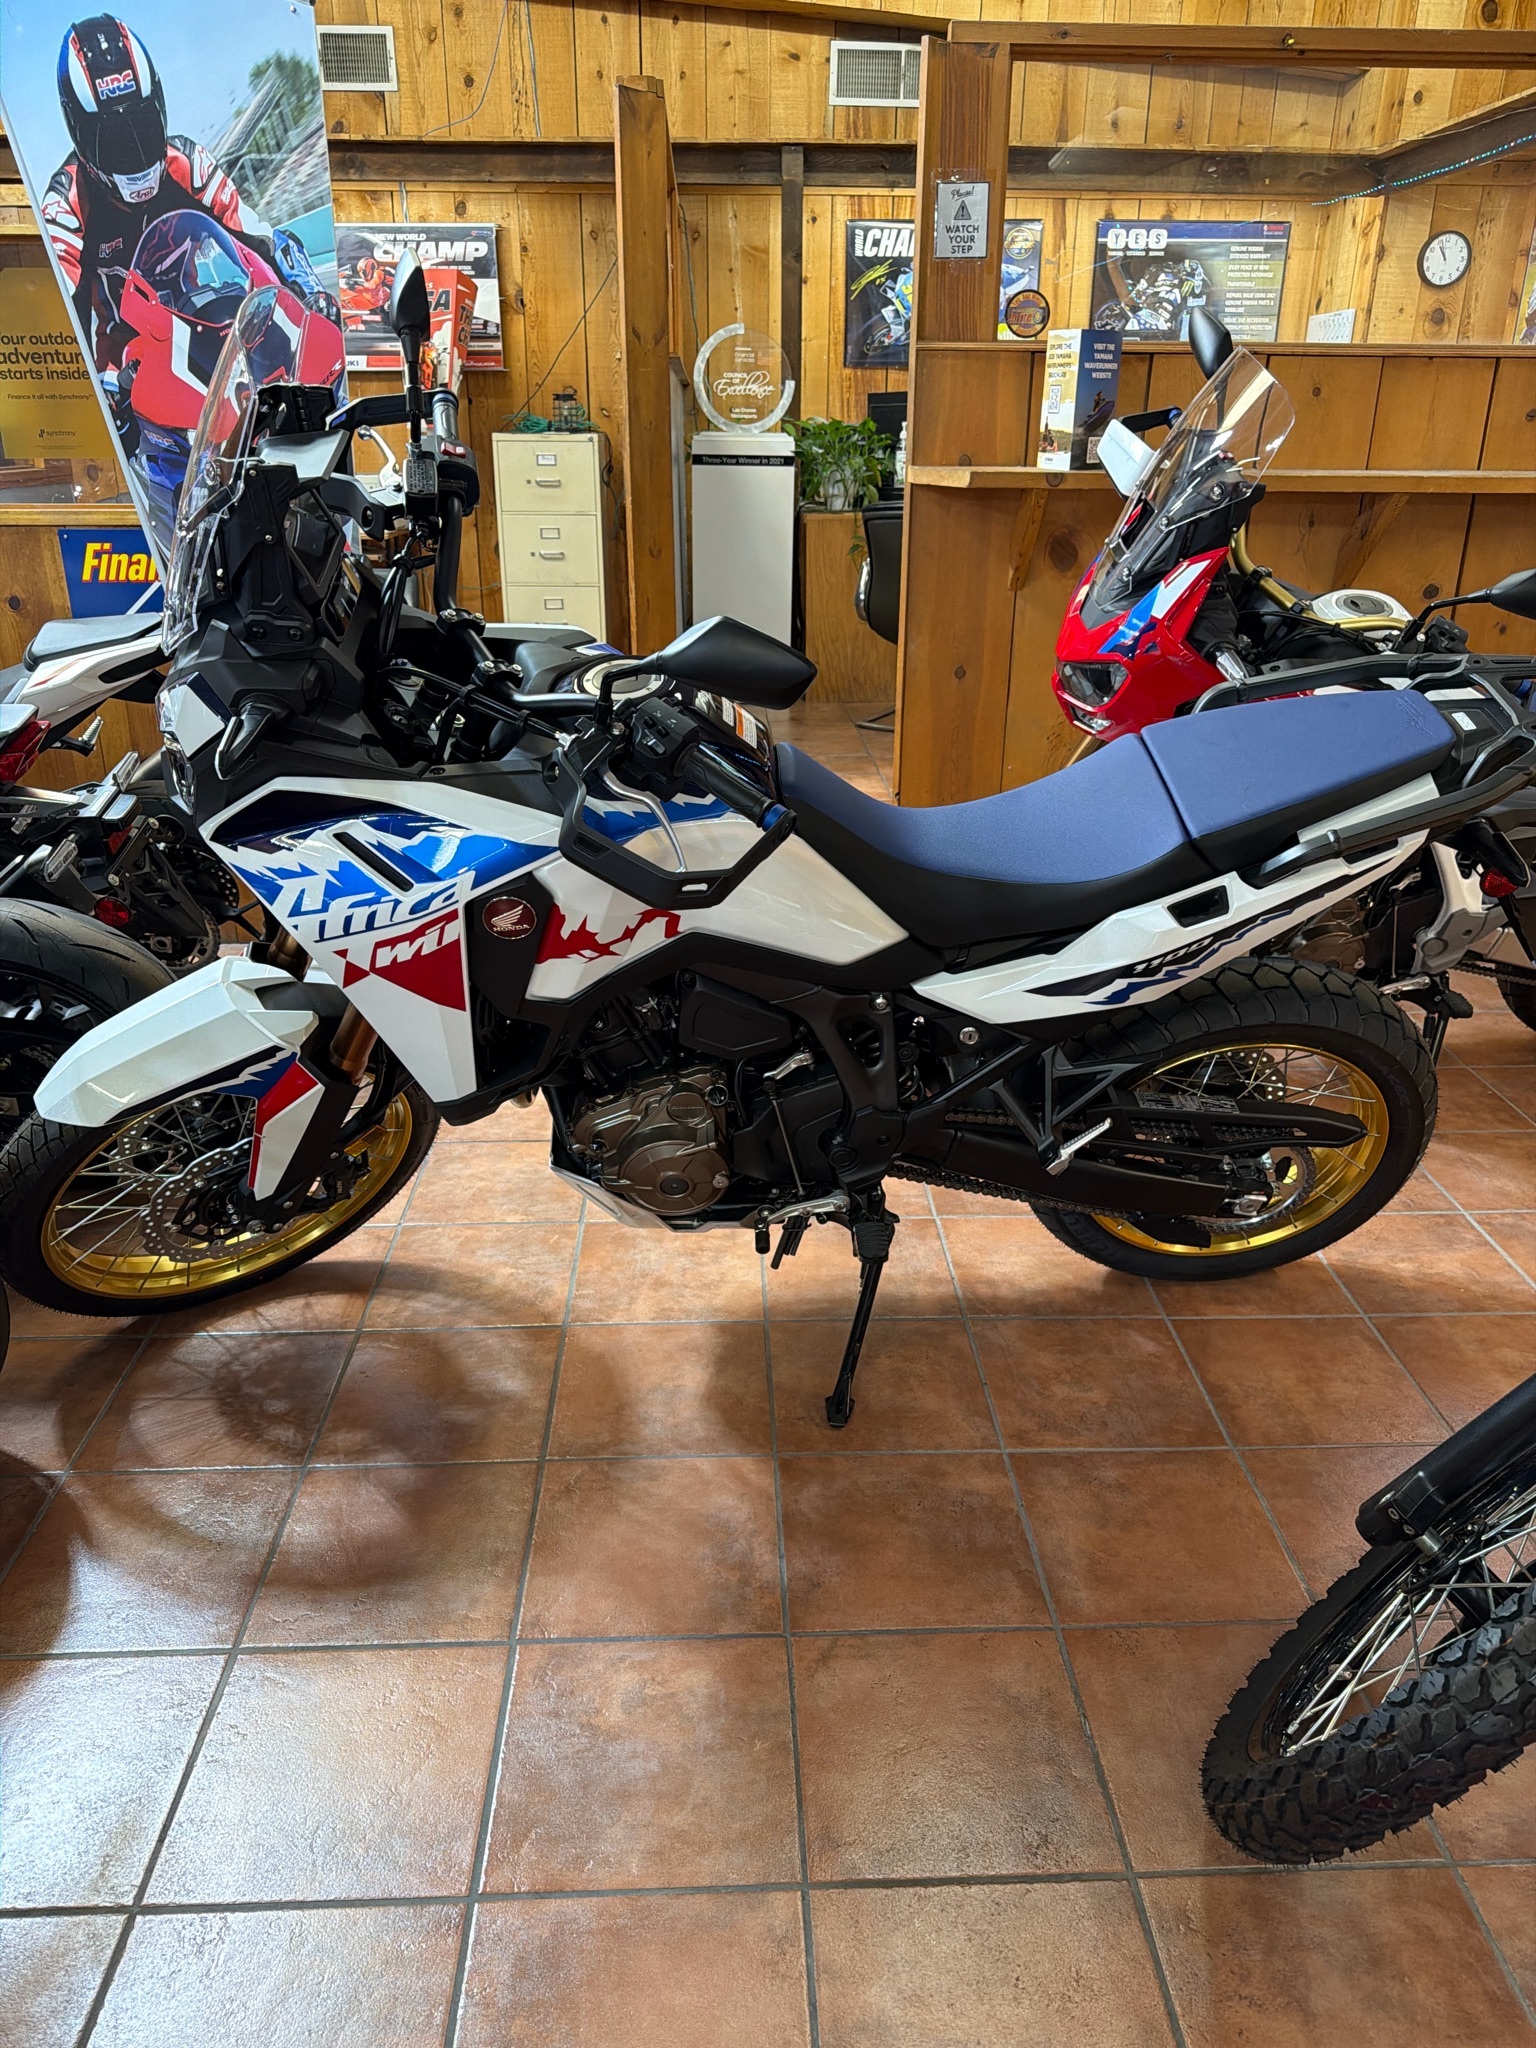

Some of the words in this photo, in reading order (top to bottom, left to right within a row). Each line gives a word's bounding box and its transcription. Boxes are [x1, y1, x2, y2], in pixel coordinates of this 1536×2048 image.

[95, 69, 136, 99] HRC
[950, 185, 975, 200] Please!
[944, 224, 980, 234] WATCH
[374, 233, 396, 241] NEW
[396, 233, 427, 241] WORLD
[855, 228, 864, 257] WORLD
[948, 234, 976, 244] YOUR
[950, 244, 973, 254] STEP
[1, 334, 26, 345] our
[29, 331, 79, 345] outdo
[1106, 343, 1116, 351] THE
[0, 347, 85, 365] adventur
[1094, 352, 1114, 360] YAMAHA
[0, 368, 43, 380] starts
[46, 367, 90, 380] inside
[713, 370, 776, 401] Excellence
[702, 456, 738, 464] Three-Year
[738, 457, 761, 465] Winner
[769, 457, 785, 465] 2021
[492, 924, 531, 932] HONDA
[1133, 936, 1215, 975] 1100
